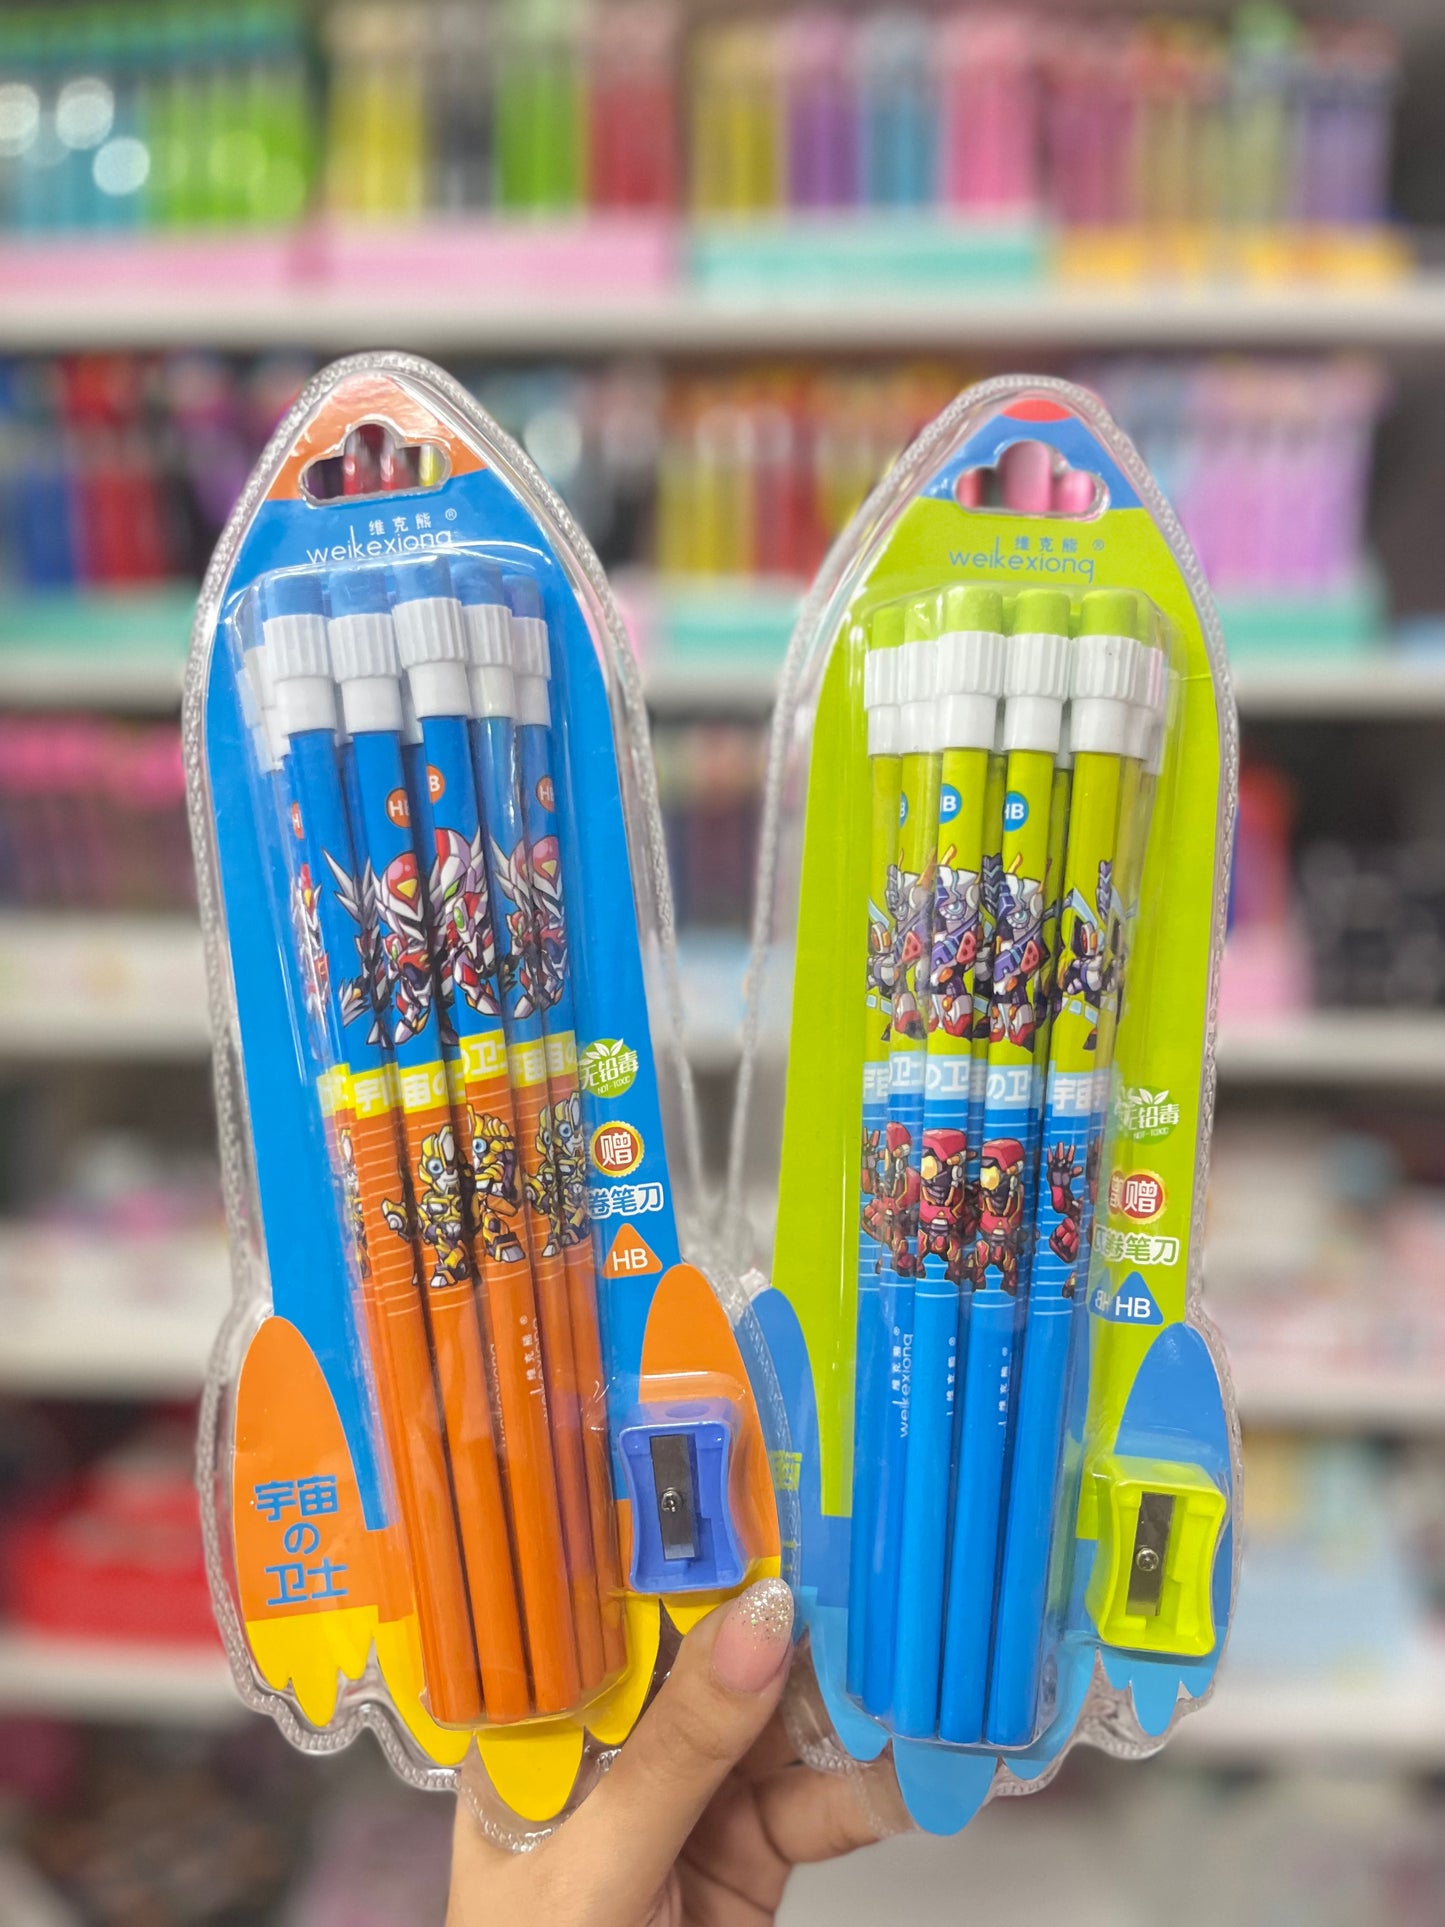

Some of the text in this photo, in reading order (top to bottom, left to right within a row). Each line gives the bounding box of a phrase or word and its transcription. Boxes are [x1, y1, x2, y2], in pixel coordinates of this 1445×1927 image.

[368, 512, 432, 537] 维克熊
[600, 1131, 633, 1167] 赠
[1125, 1180, 1158, 1213] 赠
[612, 1247, 649, 1272] HB
[1115, 1296, 1151, 1318] HB
[254, 1474, 339, 1522] 宇宙
[283, 1521, 321, 1555] の
[265, 1556, 349, 1606] 卫士
